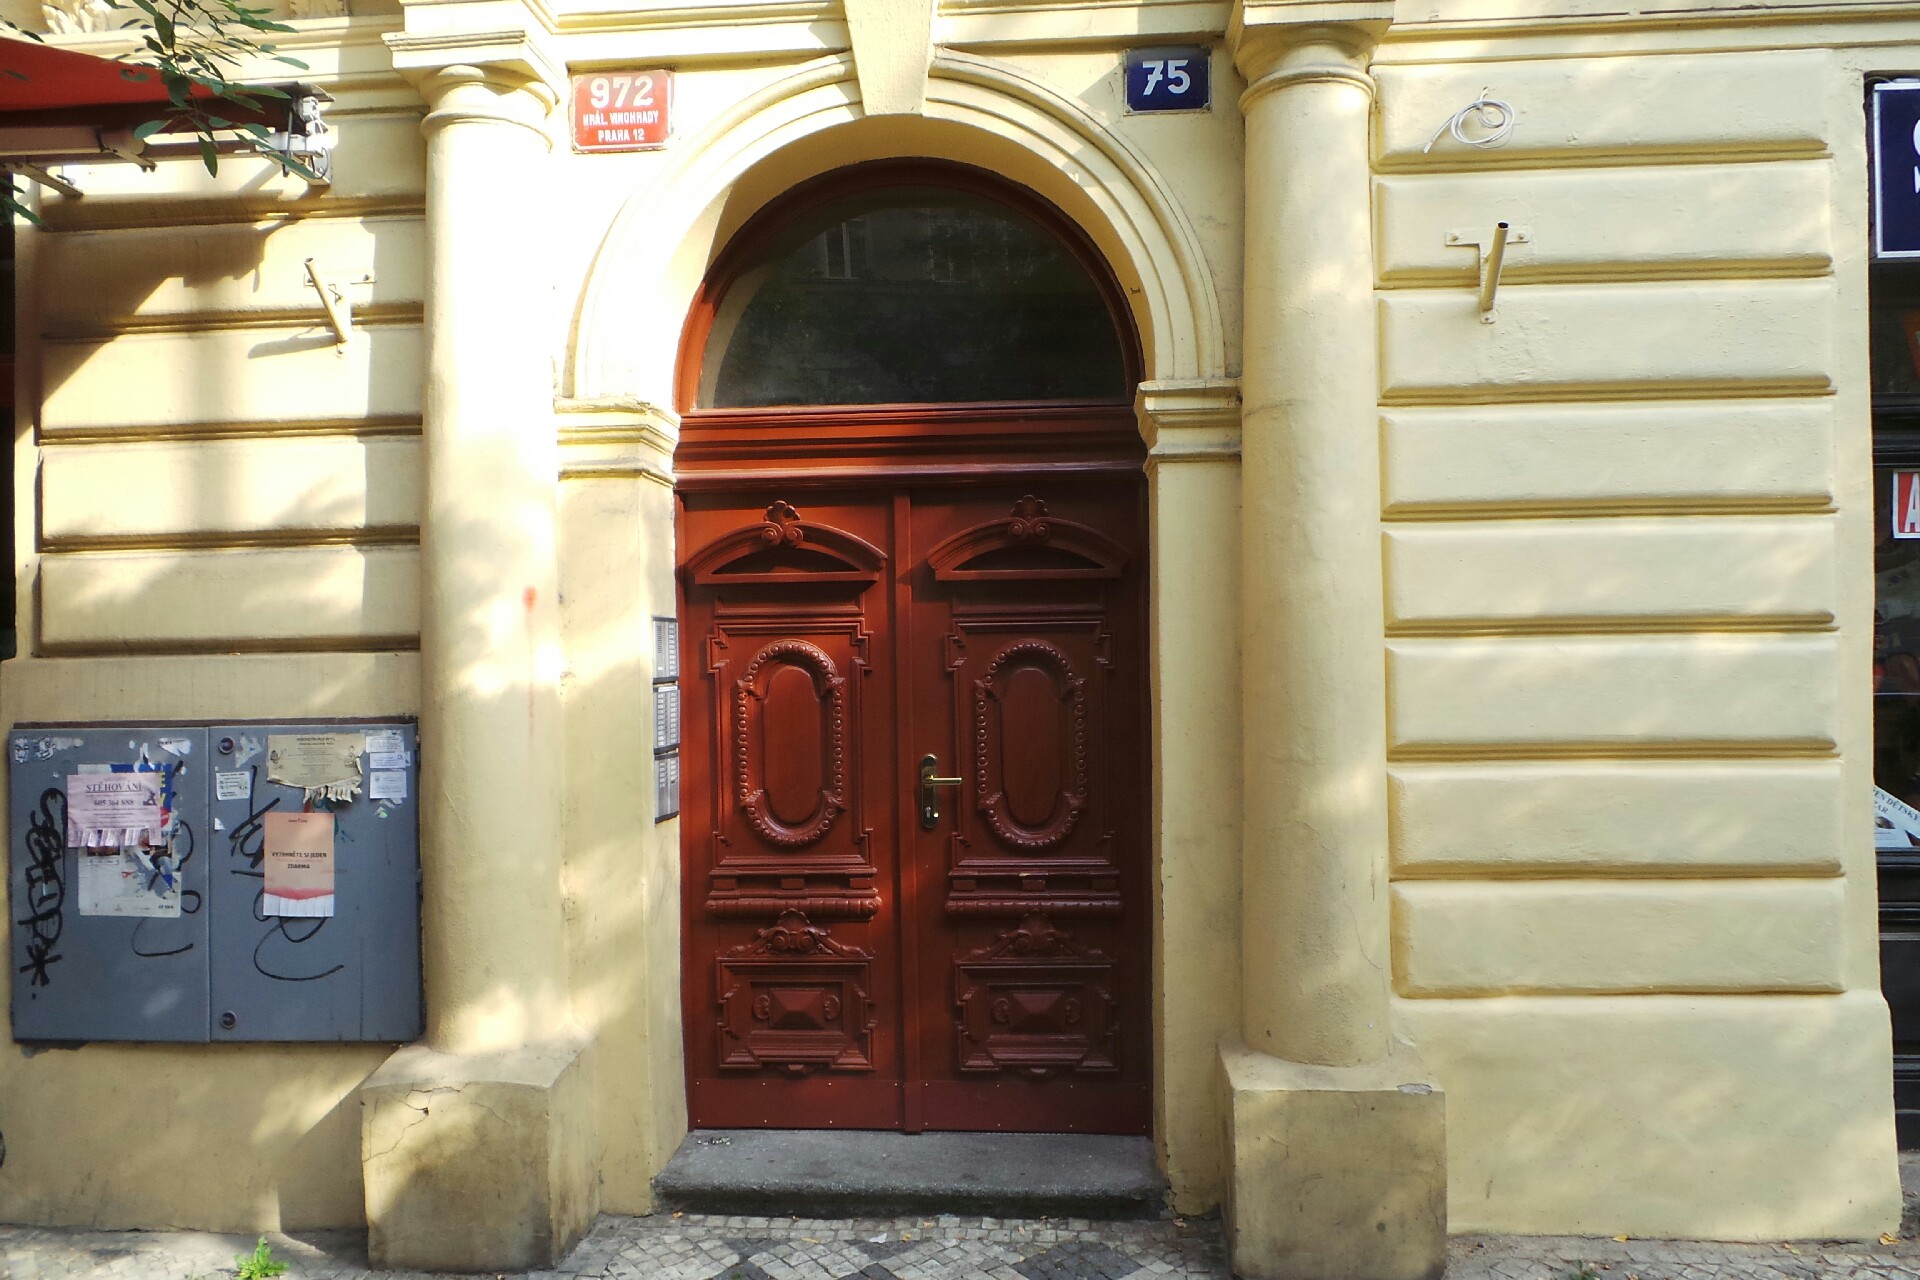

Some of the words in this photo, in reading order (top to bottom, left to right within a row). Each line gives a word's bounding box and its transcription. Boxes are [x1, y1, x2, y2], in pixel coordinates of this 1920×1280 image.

[1142, 59, 1191, 96] 75
[590, 75, 653, 108] 972
[583, 109, 608, 126] KRÁL.
[610, 110, 659, 125] VINOHRADY
[597, 129, 630, 143] PRAHA
[633, 127, 645, 141] 12
[86, 781, 142, 792] STĚHOVÁNÍ
